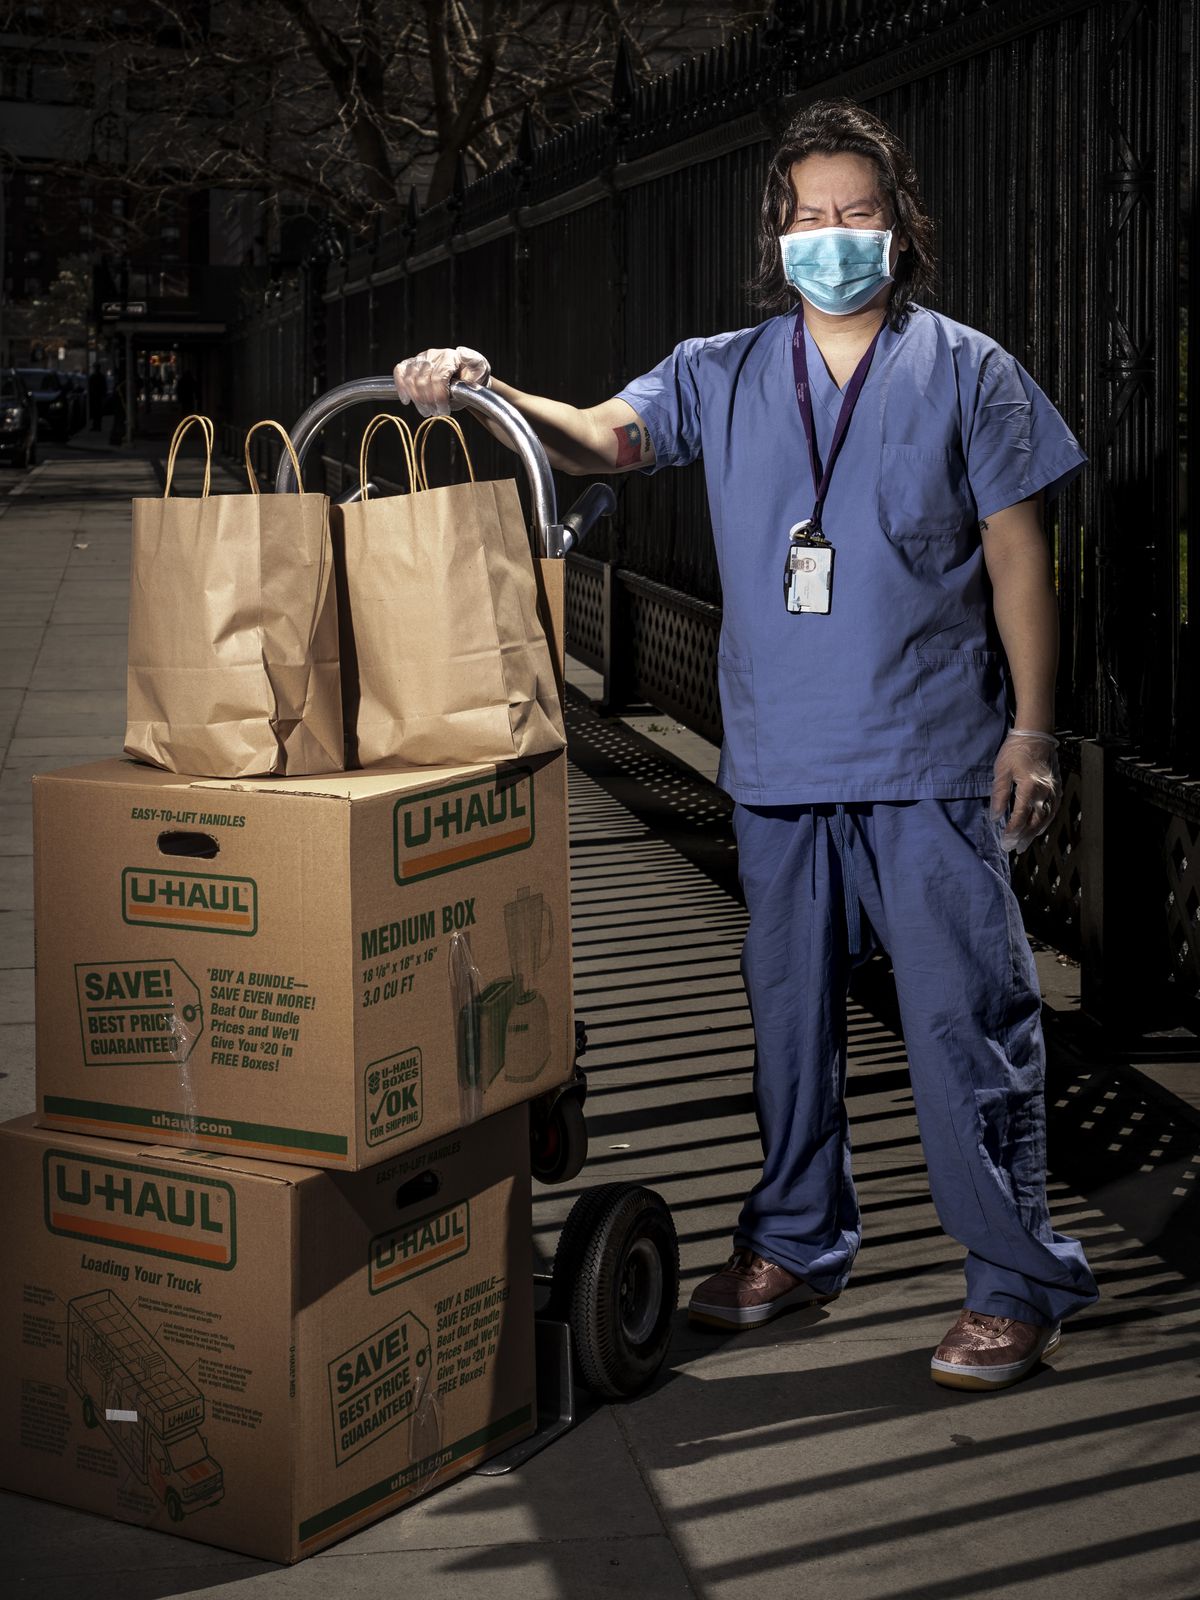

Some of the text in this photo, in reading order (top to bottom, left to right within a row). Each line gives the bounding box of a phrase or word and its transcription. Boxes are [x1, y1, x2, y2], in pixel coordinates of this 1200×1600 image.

[131, 807, 245, 828] EASY-TO-LIFT HANDLES
[404, 783, 526, 848] U-HAUL
[131, 877, 248, 912] U-HAUL
[361, 898, 476, 961] MEDIUM BOX
[85, 970, 173, 1001] SAVE!
[236, 972, 245, 985] A
[363, 969, 373, 983] 18
[363, 974, 415, 1008] 3.0 CU FT
[210, 986, 316, 1010] SAVE EVEN MORE!
[211, 1003, 299, 1024] Beat Our Bundle
[88, 1015, 125, 1034] BEST
[211, 1020, 299, 1041] Prices and We'll
[212, 1036, 293, 1057] Give You $20 in
[211, 1053, 279, 1072] FREE Boxes!
[382, 1057, 418, 1078] U-HAUL
[383, 1068, 419, 1090] BOXES
[386, 1082, 418, 1116] OK
[370, 1111, 418, 1140] FOR SHIPPING
[56, 1165, 223, 1233] U-HAUL
[376, 1212, 464, 1269] U-HAUL
[81, 1254, 202, 1294] Loading Your Truck
[437, 1286, 510, 1332] SAVE EVEN MORE!
[455, 1292, 461, 1306] A
[437, 1309, 500, 1348] Beat Our Bundle
[337, 1324, 409, 1394] SAVE!
[437, 1344, 461, 1364] Prices
[464, 1333, 479, 1351] and
[437, 1343, 496, 1381] Give You $20 in
[437, 1361, 486, 1398] FREE Boxes!
[339, 1367, 410, 1429] BEST PRICE
